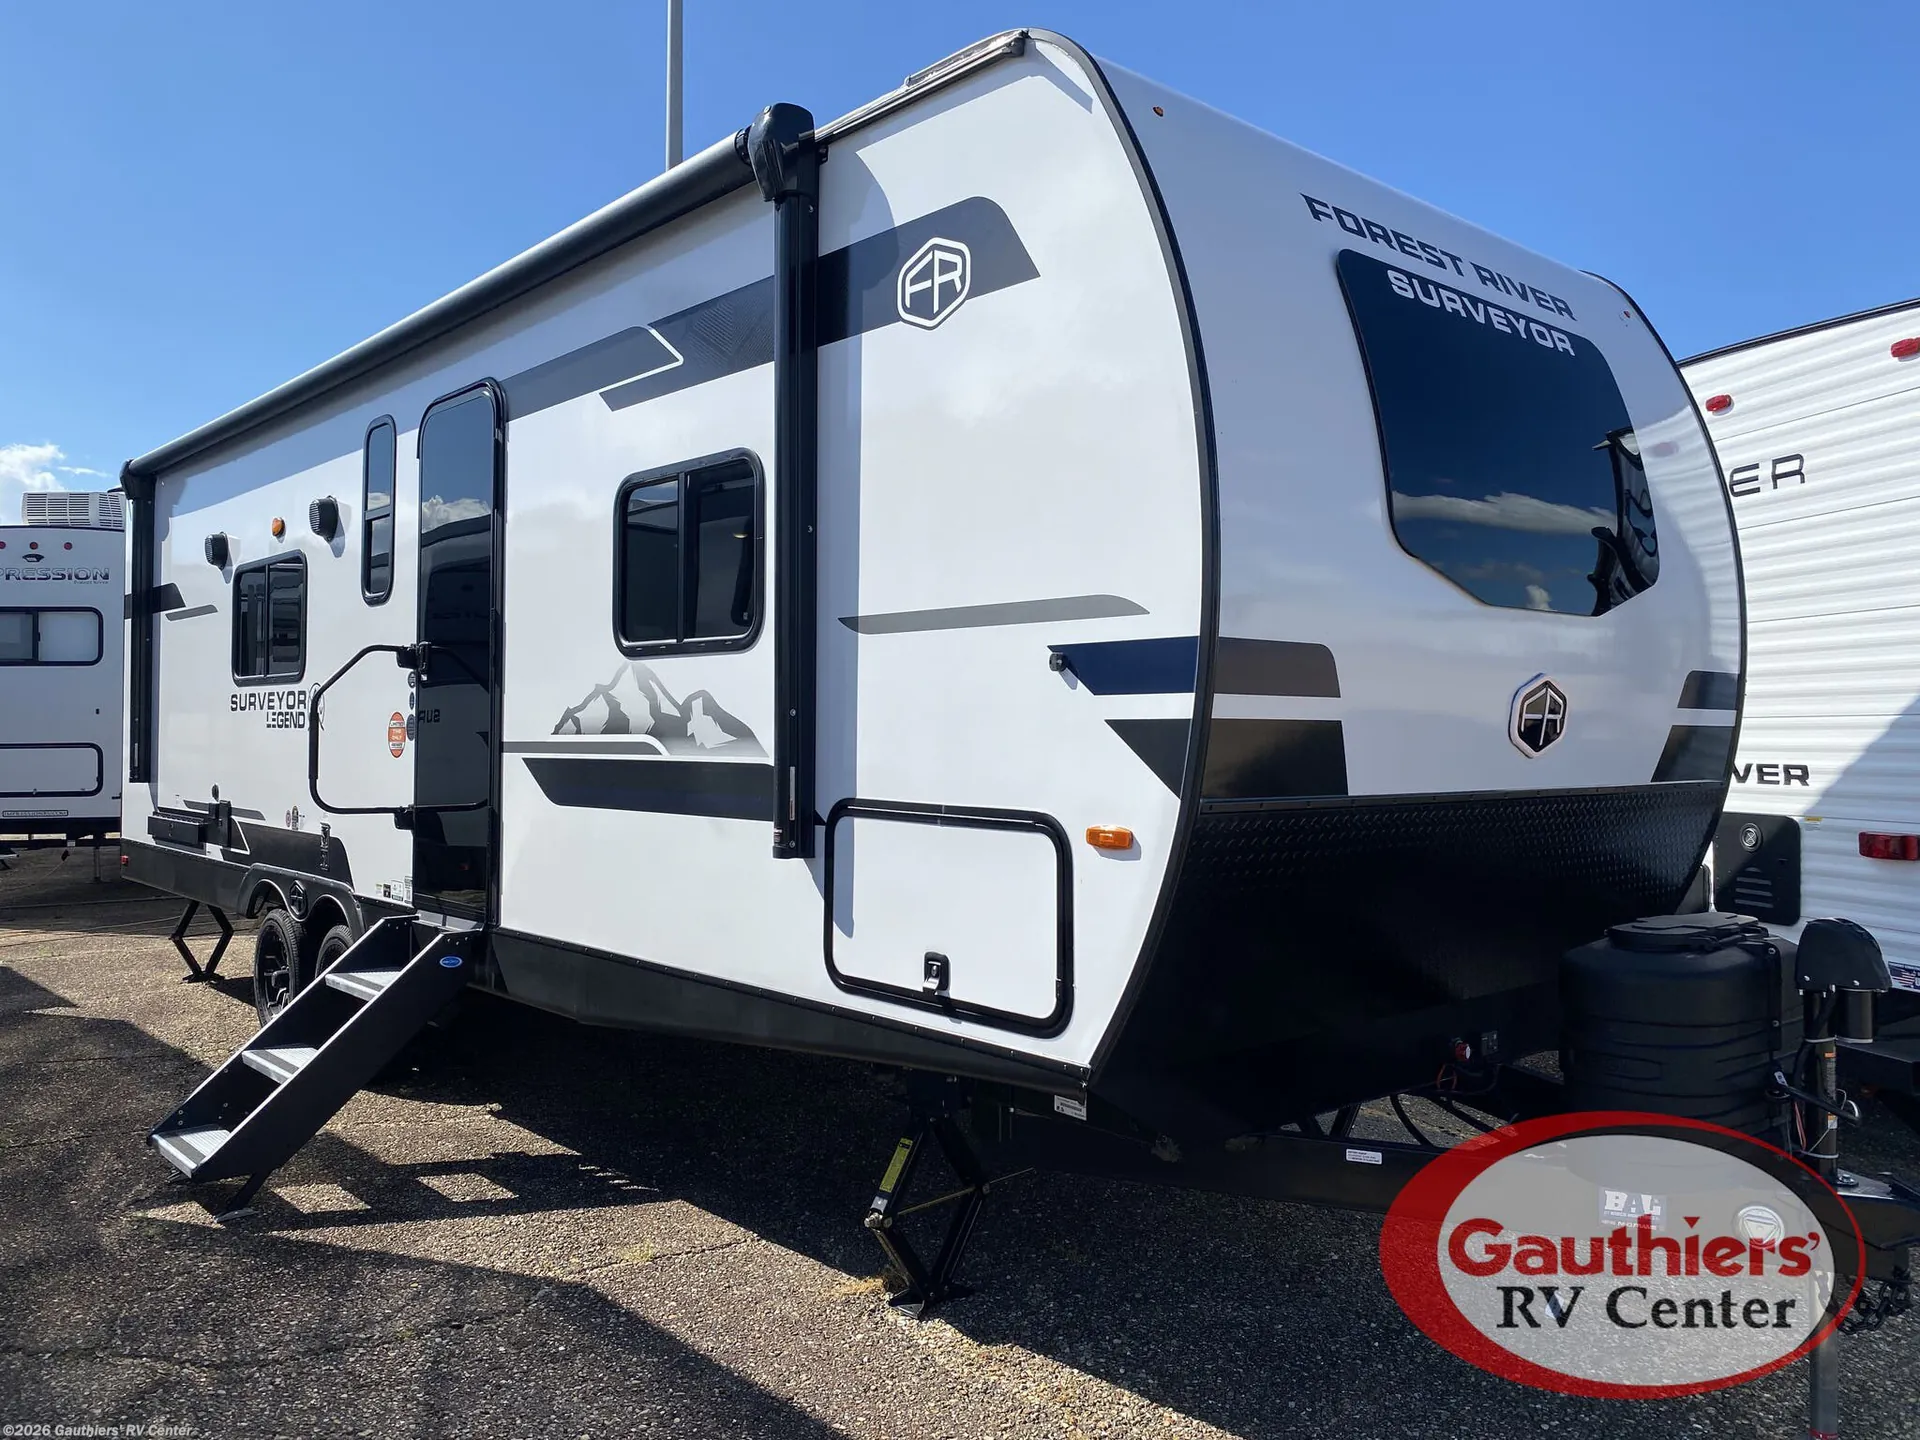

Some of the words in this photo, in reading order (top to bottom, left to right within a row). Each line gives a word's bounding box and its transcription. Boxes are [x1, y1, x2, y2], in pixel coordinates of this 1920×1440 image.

[1300, 193, 1464, 276] FOREST
[1470, 261, 1577, 321] RIVER
[1387, 270, 1575, 356] SURVEYOR
[230, 690, 306, 711] SURVEYOR
[266, 711, 305, 728] LEGEND
